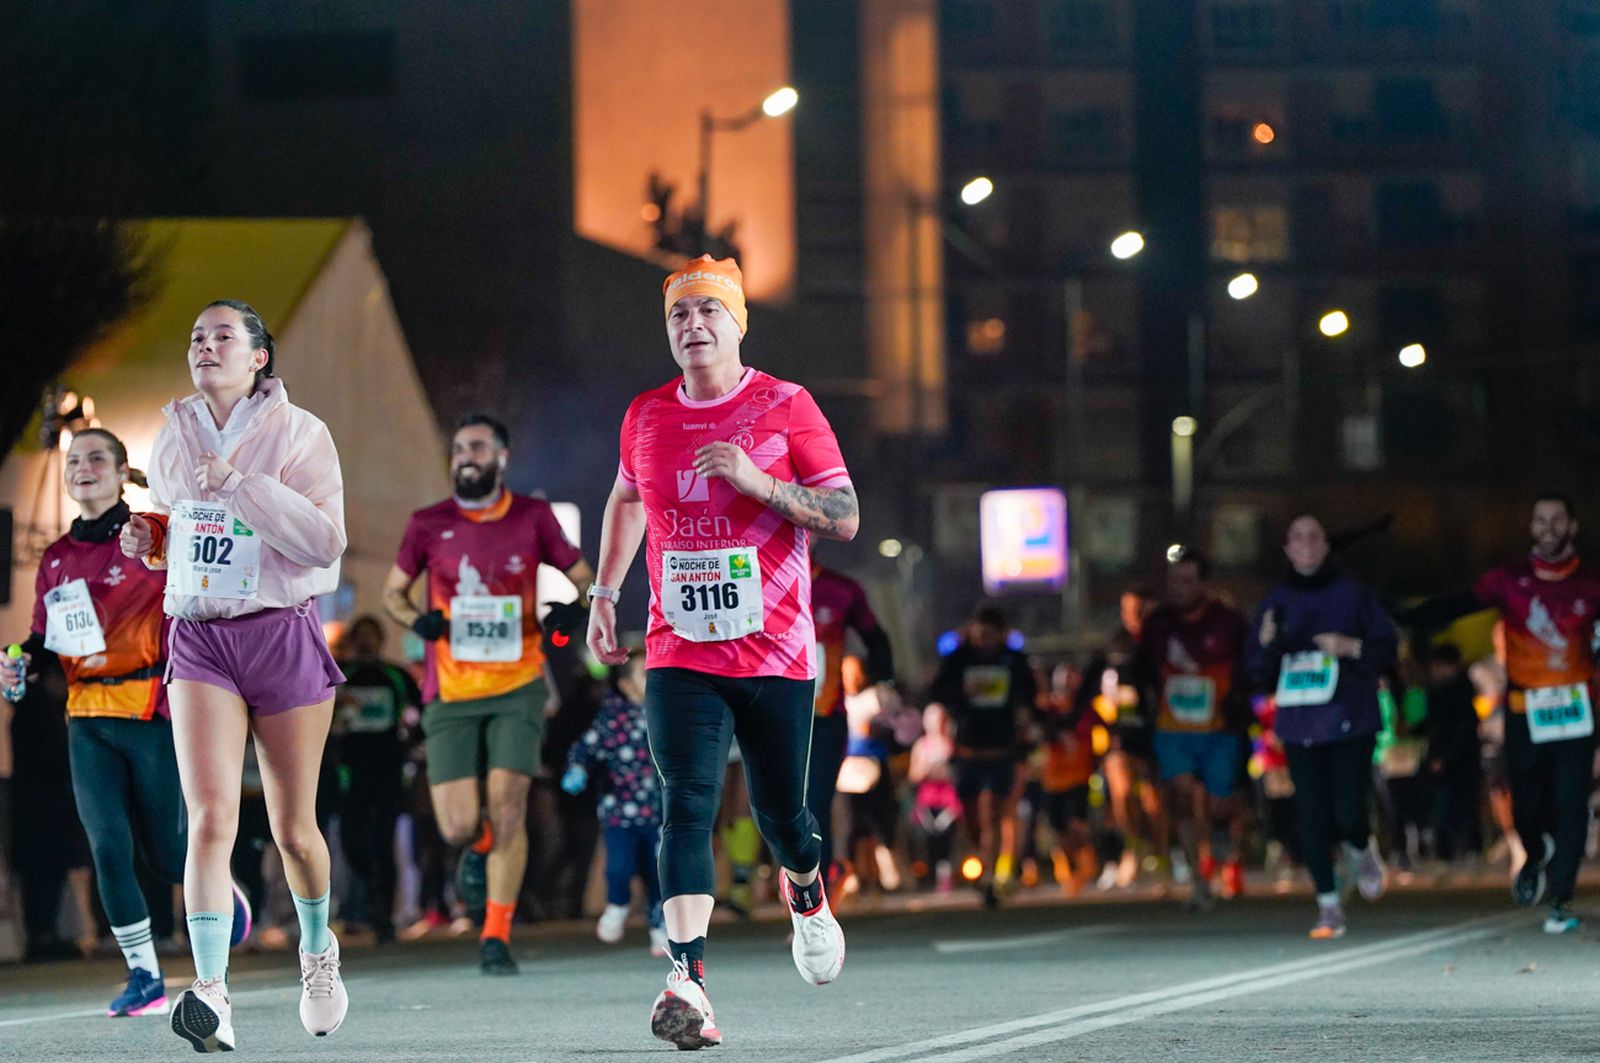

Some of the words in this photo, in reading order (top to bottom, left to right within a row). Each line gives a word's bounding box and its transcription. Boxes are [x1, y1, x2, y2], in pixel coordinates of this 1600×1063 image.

[214, 513, 226, 523] DE
[663, 508, 732, 539] Jaén
[188, 535, 234, 566] 502
[696, 538, 747, 550] INTERIOR
[678, 561, 707, 571] NOCHE
[708, 560, 720, 570] DE
[670, 572, 688, 583] SAN
[688, 570, 721, 583] ANTÓN
[680, 582, 739, 612] 3116
